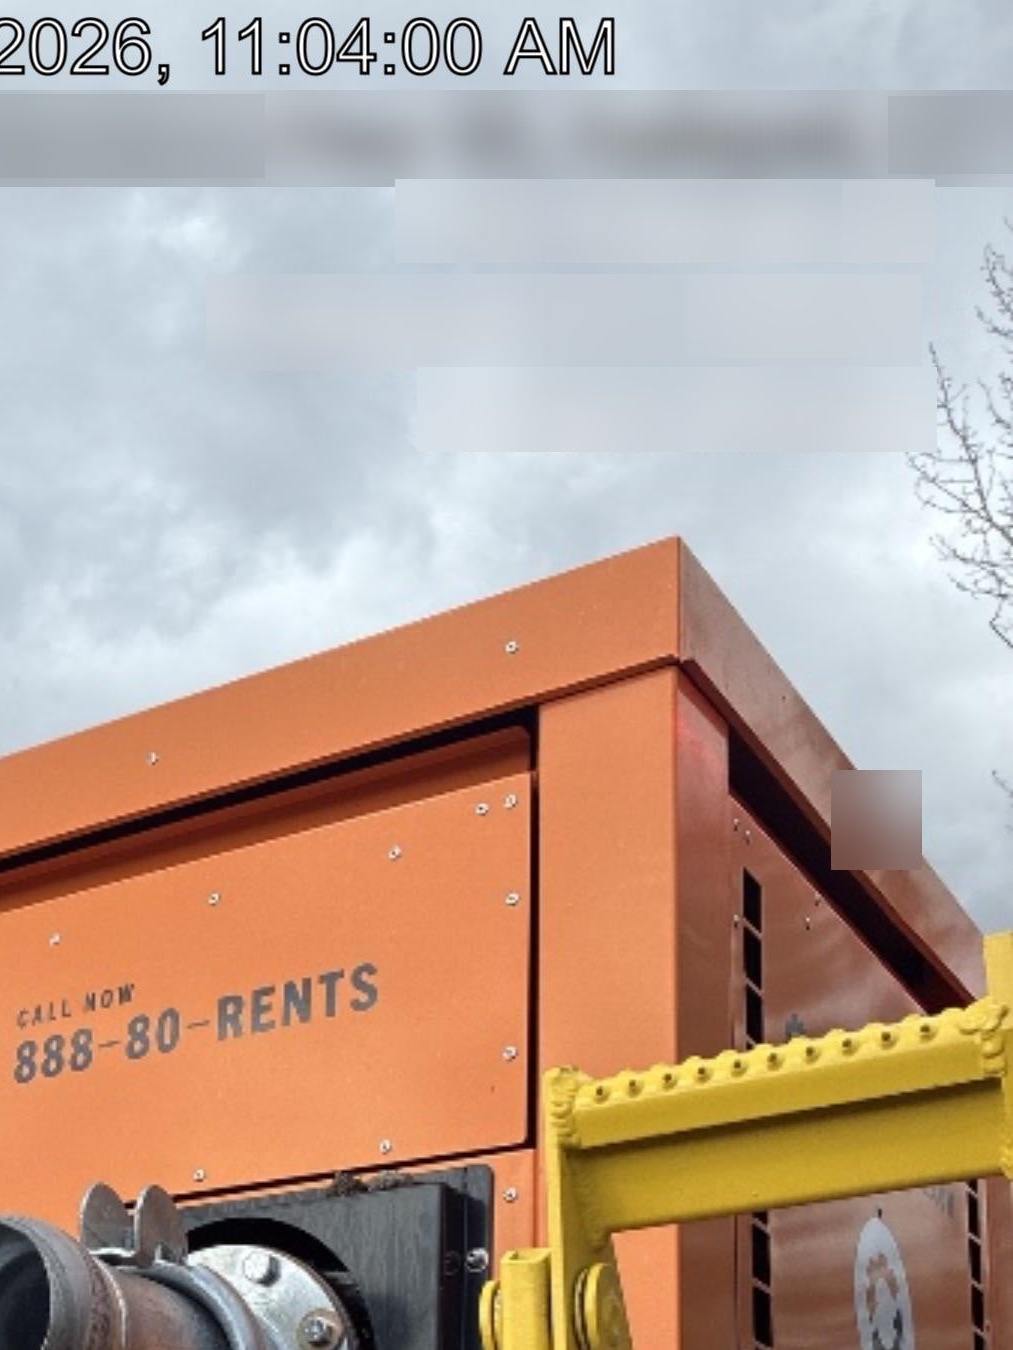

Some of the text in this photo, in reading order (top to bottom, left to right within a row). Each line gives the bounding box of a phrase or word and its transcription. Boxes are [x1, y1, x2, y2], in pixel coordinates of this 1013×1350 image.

[13, 962, 379, 1084] 888-80-RENTS
[17, 982, 136, 1028] CALL NOW
